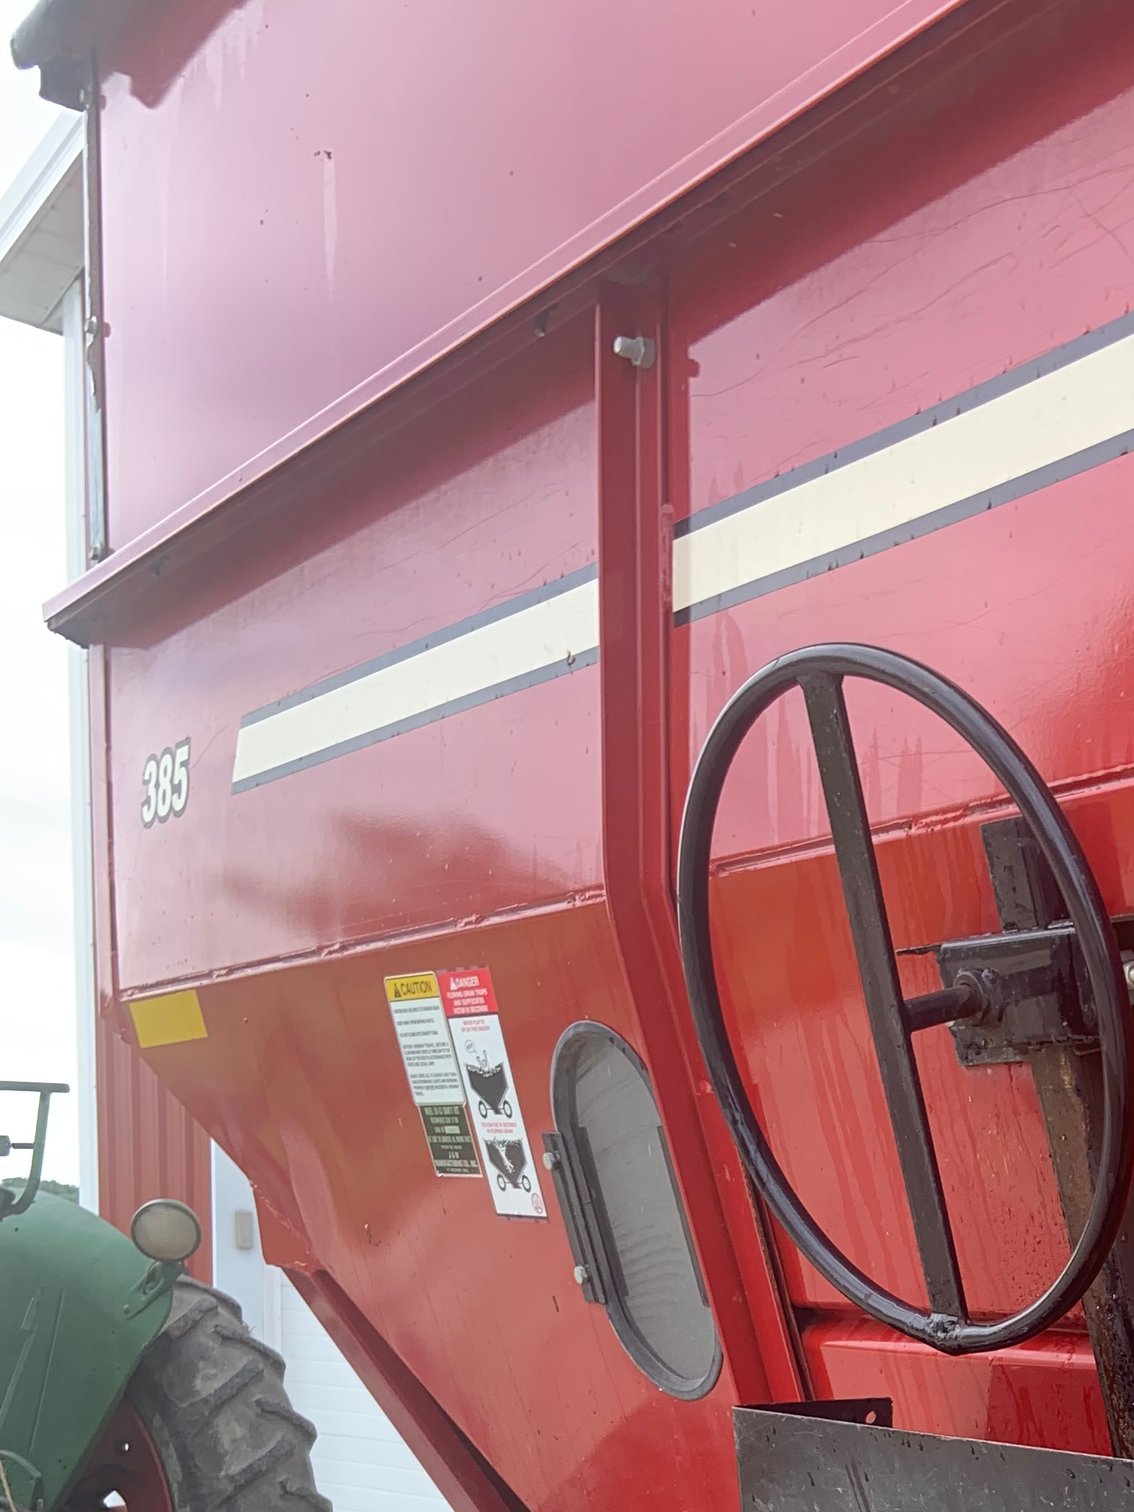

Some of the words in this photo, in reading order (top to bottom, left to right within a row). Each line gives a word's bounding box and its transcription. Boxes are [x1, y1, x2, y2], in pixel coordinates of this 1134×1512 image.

[141, 738, 190, 828] 385
[400, 980, 433, 996] CAUTION
[455, 975, 480, 988] DANGER
